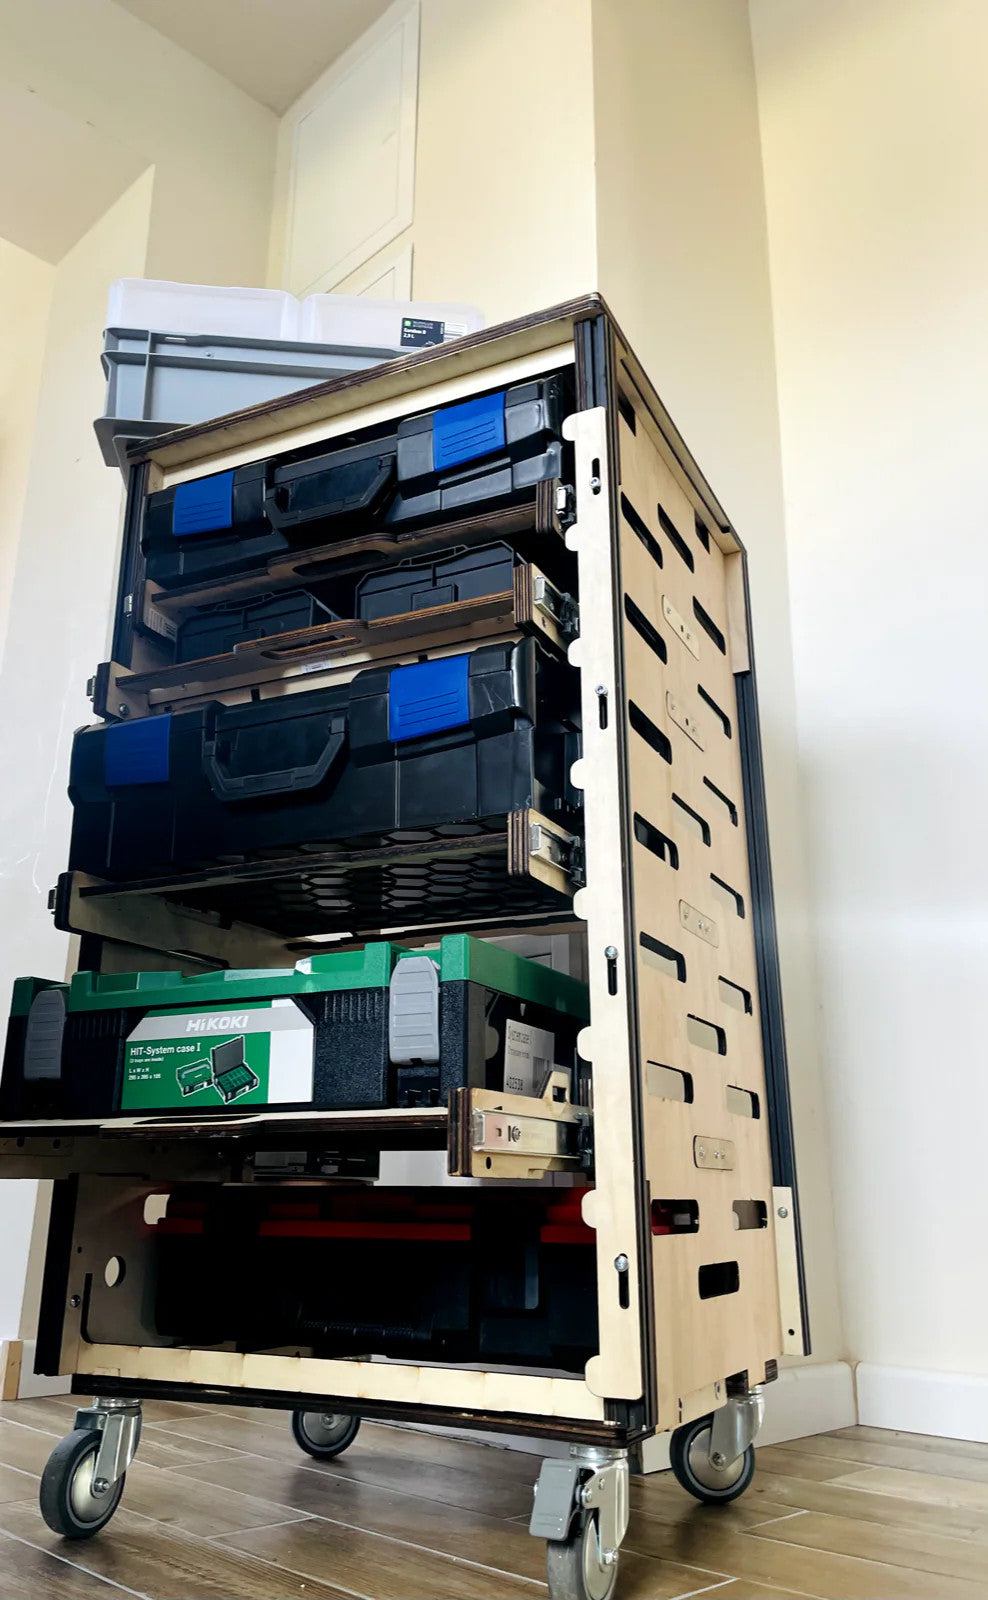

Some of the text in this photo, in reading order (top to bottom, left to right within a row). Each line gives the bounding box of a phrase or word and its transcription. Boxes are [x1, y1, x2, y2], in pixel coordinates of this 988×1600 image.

[185, 1015, 250, 1032] HiKOKI
[130, 1046, 175, 1056] HIT-System
[176, 1045, 195, 1053] case
